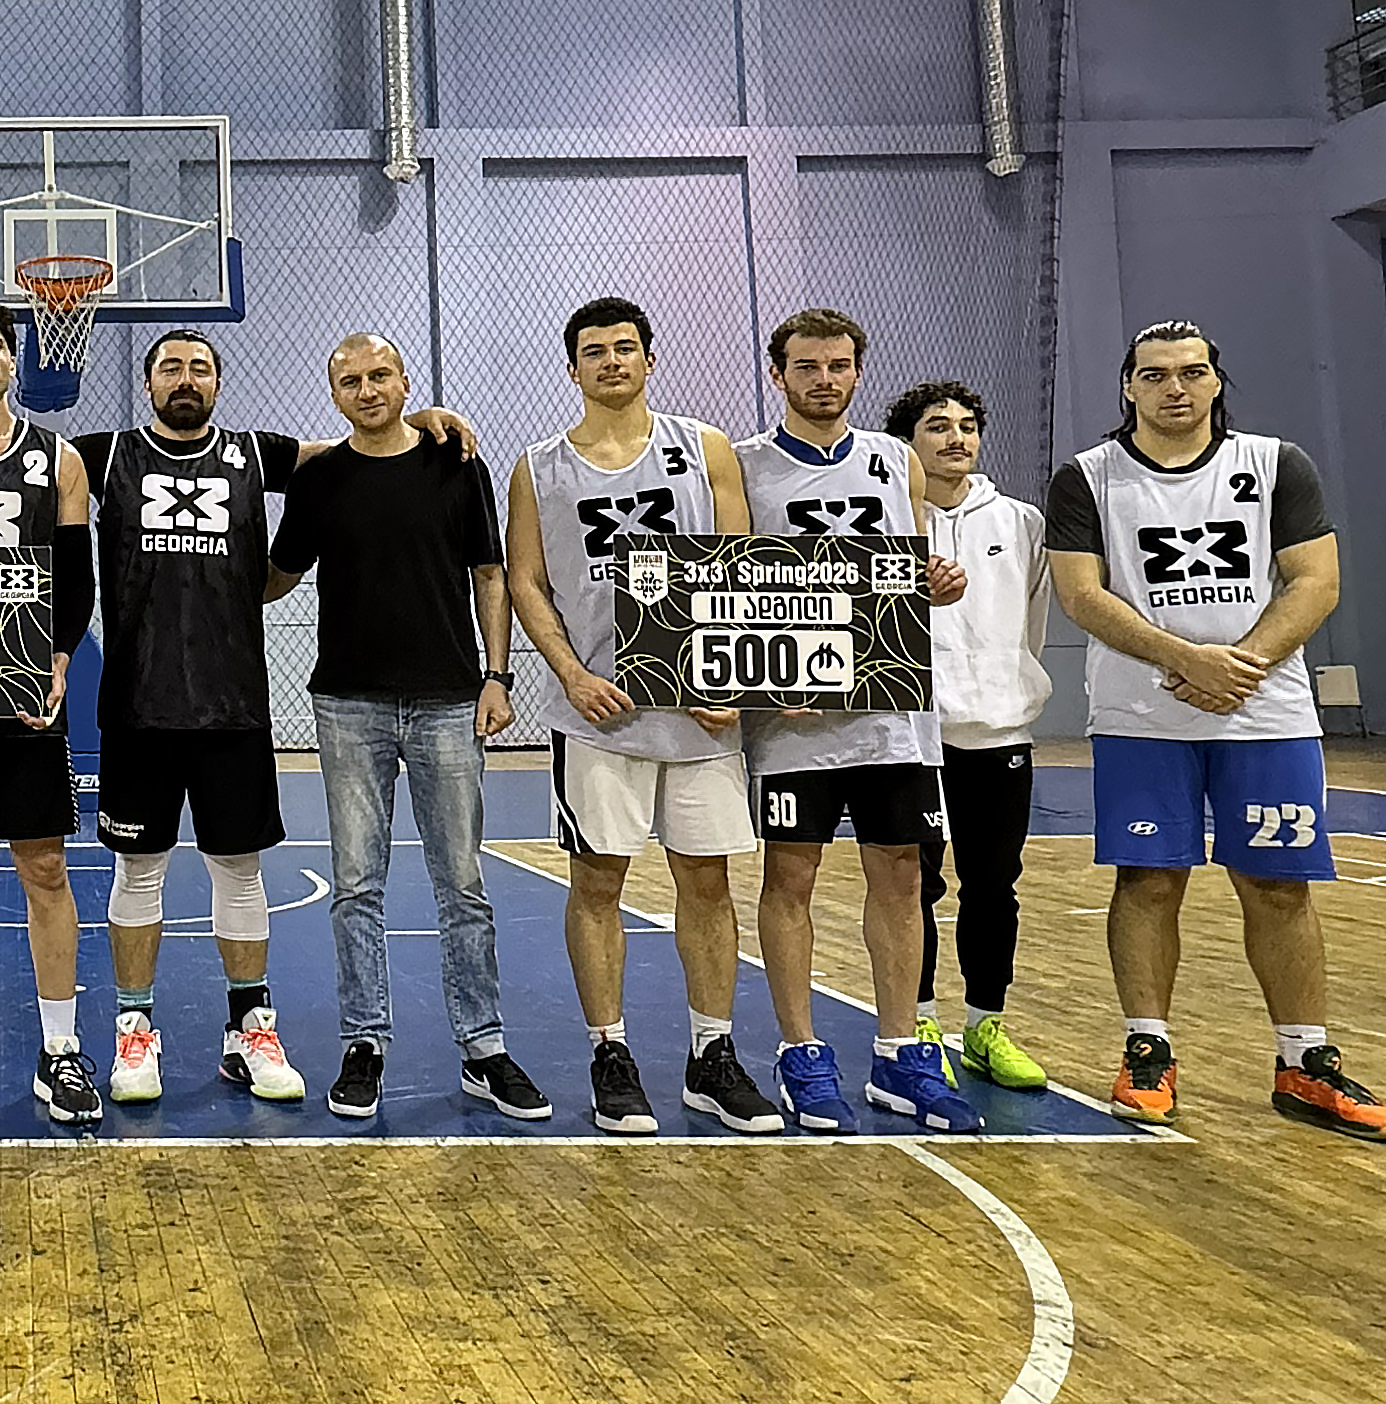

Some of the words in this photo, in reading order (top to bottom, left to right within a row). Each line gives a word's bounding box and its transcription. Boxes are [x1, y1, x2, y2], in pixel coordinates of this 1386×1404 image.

[23, 450, 48, 487] 2
[223, 444, 246, 469] 4
[662, 447, 687, 476] 3
[868, 454, 890, 485] 4
[1229, 473, 1260, 503] 2
[142, 534, 228, 556] GEORGIA
[683, 561, 724, 583] 3x3
[737, 561, 860, 586] Spring2026
[711, 596, 735, 619] III
[1149, 586, 1256, 608] GEORGIA
[768, 792, 797, 828] 30
[1246, 803, 1316, 847] 23
